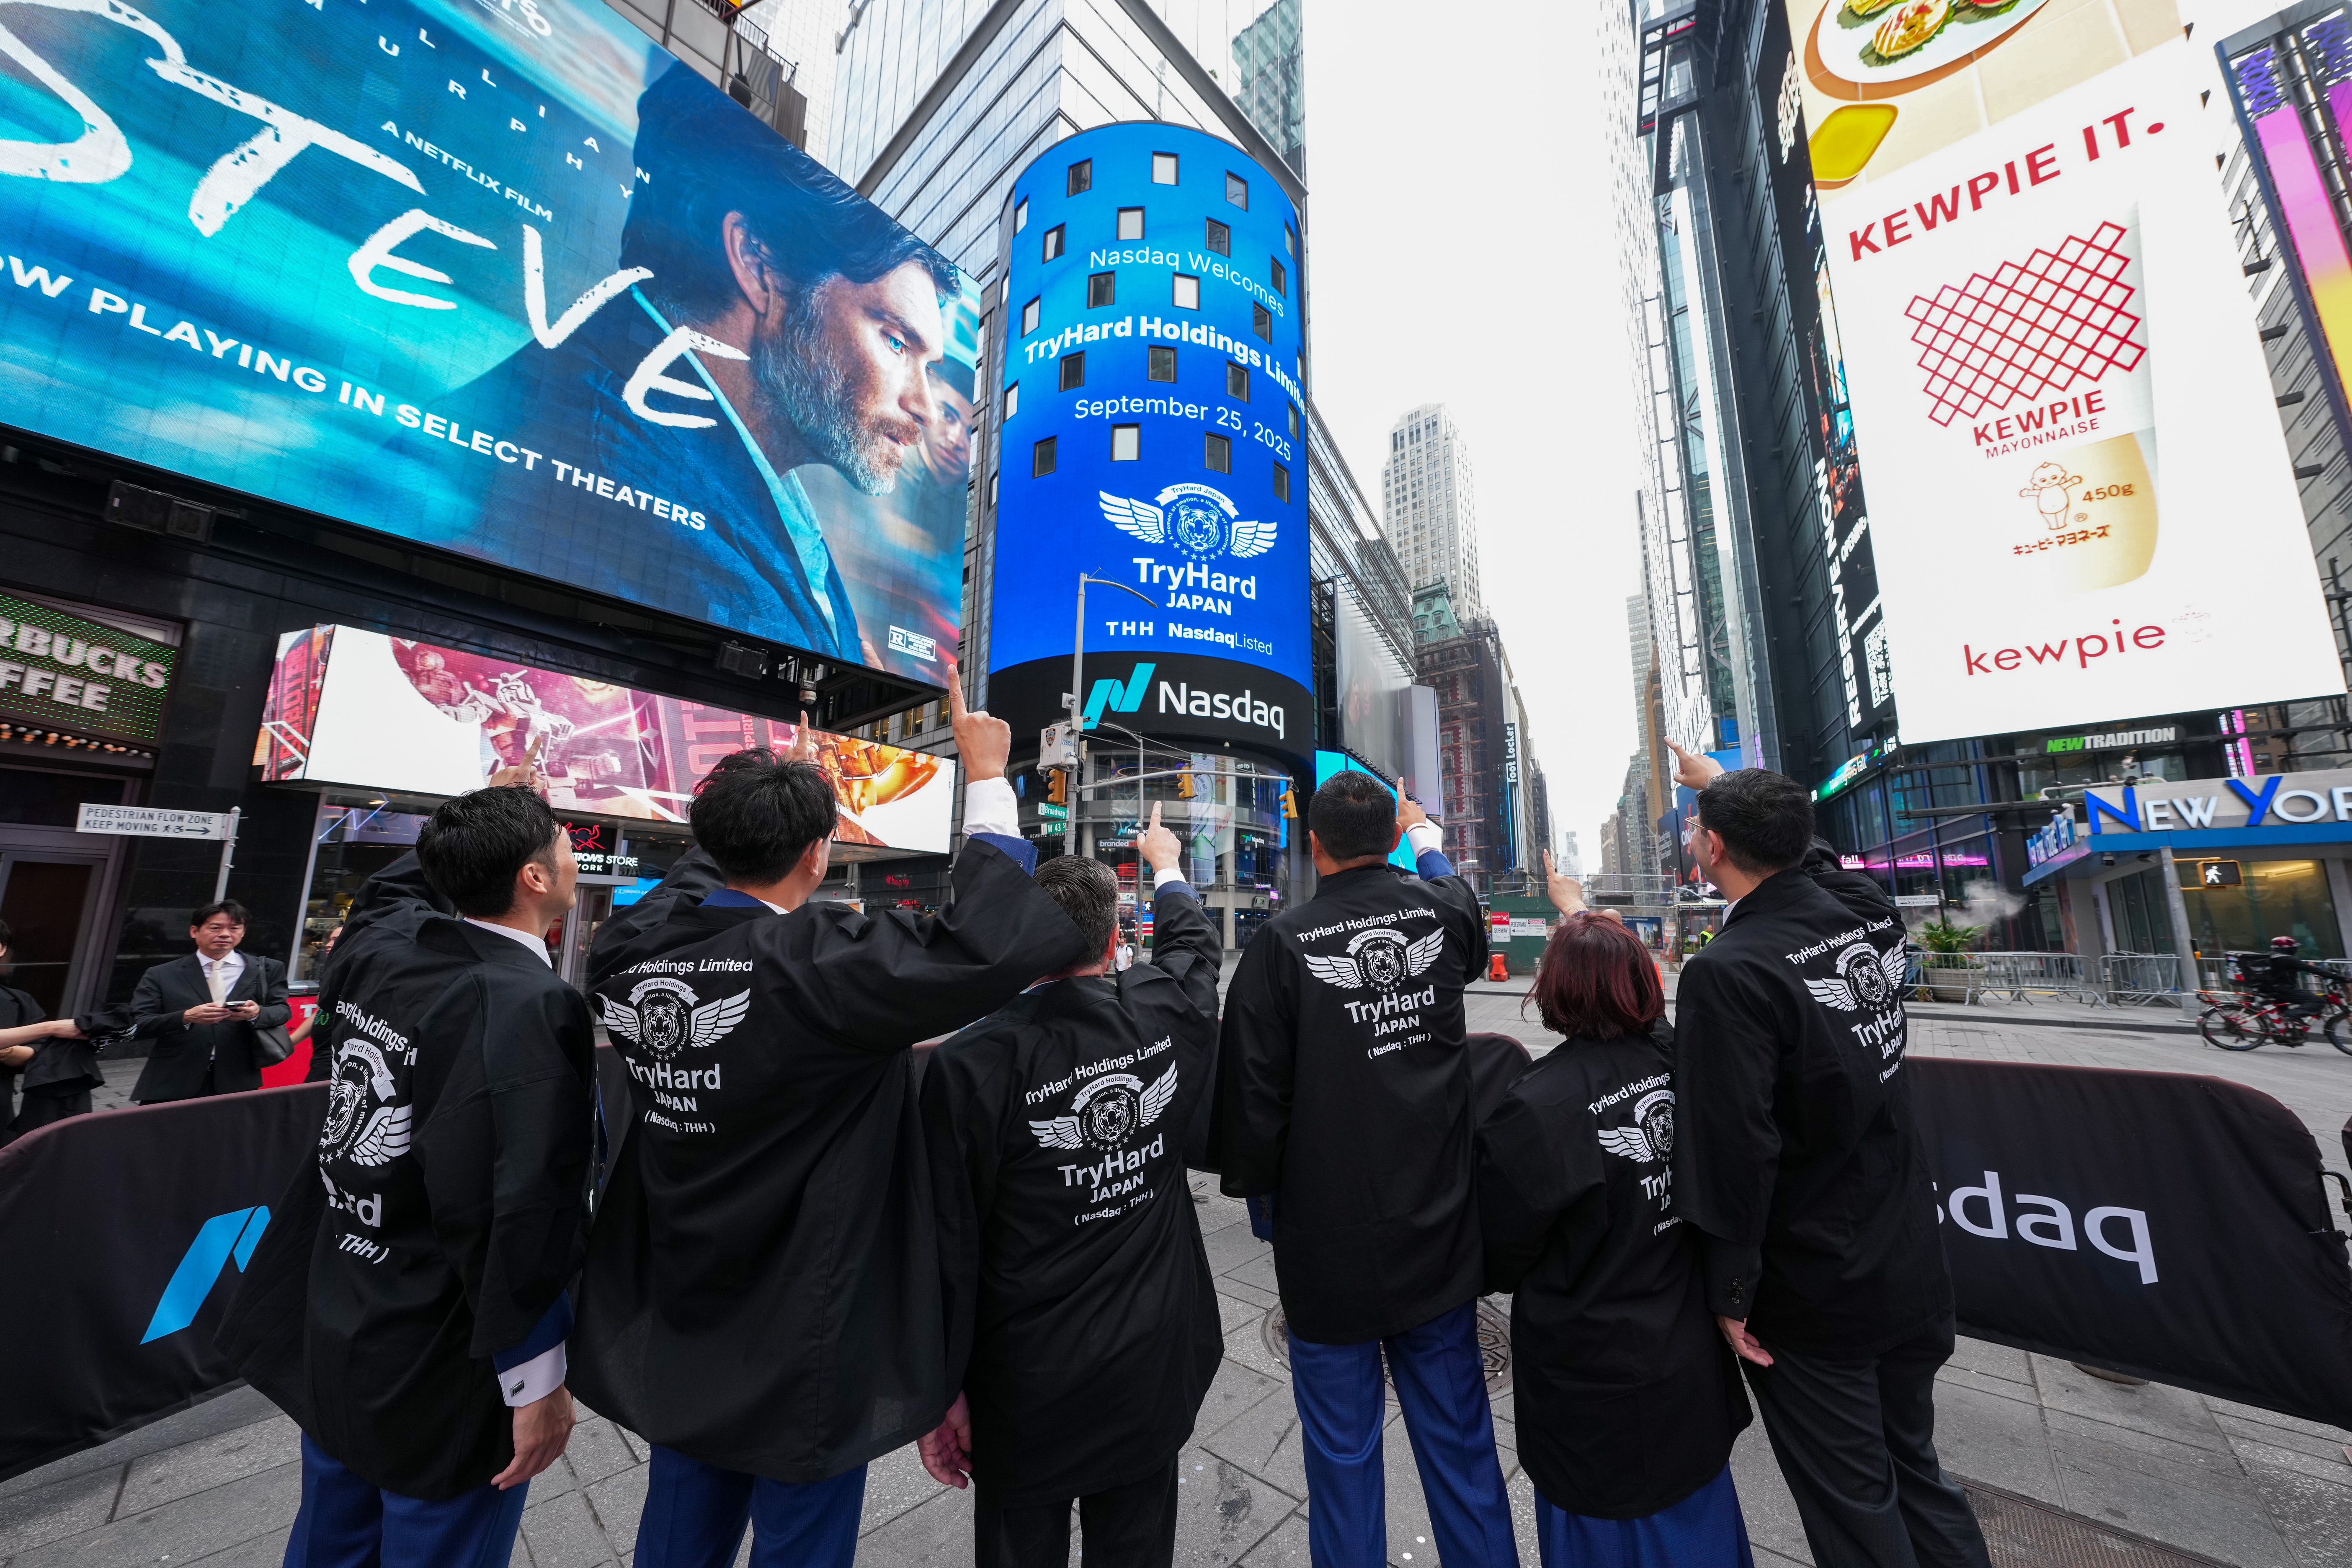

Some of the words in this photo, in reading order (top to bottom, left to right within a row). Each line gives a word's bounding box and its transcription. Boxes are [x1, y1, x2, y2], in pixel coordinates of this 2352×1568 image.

[380, 120, 400, 138] A
[405, 130, 501, 194] NETFLIX
[504, 187, 553, 222] FILM
[1849, 143, 2061, 262] KEWPIE
[2082, 106, 2165, 162] IT.
[0, 0, 751, 428] STEVE
[1091, 246, 1180, 271] Nasdaq
[1188, 251, 1284, 317] Welcomes
[1025, 316, 1132, 364] TryHard
[1140, 317, 1262, 367] Holdings
[1266, 353, 1306, 416] Limite
[88, 287, 327, 393] PLAYING
[338, 381, 385, 416] IN
[395, 404, 543, 471] SELECT
[551, 459, 707, 531] THEATERS
[1973, 389, 2106, 446] KEWPIE
[1075, 395, 1209, 420] September
[1216, 406, 1248, 438] 25,
[1254, 422, 1291, 461] 2025
[1985, 418, 2100, 459] MAYONNAISE
[1171, 485, 1202, 493] TryHard
[1203, 488, 1225, 503] Japan
[2082, 483, 2135, 502] 450g
[1176, 497, 1199, 507] emotion,
[1205, 499, 1223, 517] lifetime
[1815, 457, 1837, 558] NOW
[1133, 558, 1256, 601] TryHard
[1166, 592, 1232, 616] JAPAN
[1106, 621, 1154, 636] THH
[1829, 554, 1862, 729] RESERVE
[1963, 618, 2166, 676] kewpie
[1159, 681, 1284, 740] Nasdaq
[1505, 726, 1516, 759] Locker
[2046, 727, 2176, 753] NEWTRADITION
[1507, 761, 1517, 783] Foot
[1856, 753, 1867, 773] fall
[86, 808, 154, 820] PEDESTRIAN
[157, 813, 184, 823] FLOW
[187, 815, 214, 825] ZONE
[1044, 805, 1066, 820] Broadway
[2084, 787, 2219, 835] NEW
[84, 820, 113, 829] KEEP
[116, 822, 158, 832] MOVING
[1047, 824, 1053, 833] W
[1054, 823, 1061, 832] 43
[573, 852, 604, 863] TIONS
[606, 855, 638, 867] STORE
[1841, 855, 1859, 864] fall
[1297, 922, 1344, 943] TryHard
[1346, 913, 1398, 931] Holdings
[1353, 931, 1373, 944] TryHard
[1362, 940, 1377, 953] emotion,
[1381, 939, 1397, 949] lifetime
[1785, 941, 1828, 965] TryHard
[1825, 927, 1865, 949] Holdings
[1839, 948, 1855, 963] TryHard
[638, 959, 695, 975] Holdings
[699, 958, 753, 972] Limited
[1849, 957, 1861, 972] emotion,
[1863, 954, 1877, 963] lifetime
[636, 980, 658, 993] TryHard
[660, 980, 686, 993] Holdings
[1849, 979, 1859, 998] moment
[665, 993, 681, 1008] lifetime
[1344, 984, 1436, 1024] TryHard
[1374, 1014, 1420, 1037] JAPAN
[1373, 1041, 1402, 1057] Nasdaq
[1408, 1033, 1426, 1045] THH
[1882, 1029, 1903, 1060] JAPAN
[365, 1046, 384, 1078] Holdings
[1074, 1054, 1134, 1080] Holdings
[1136, 1035, 1172, 1061] Limited
[625, 1055, 721, 1090] TryHard
[1628, 1072, 1671, 1096] Holdings
[1080, 1079, 1105, 1098] TryHard
[1089, 1091, 1109, 1108] emotion,
[1114, 1088, 1131, 1098] lifetime
[362, 1099, 367, 1109] of
[654, 1090, 697, 1112] JAPAN
[1636, 1095, 1654, 1112] TryHard
[650, 1112, 678, 1133] Nasdaq
[683, 1122, 708, 1133] THH
[1648, 1105, 1659, 1121] emotion,
[343, 1111, 366, 1151] memories
[1646, 1128, 1655, 1149] moment
[1057, 1132, 1164, 1189] TryHard
[1089, 1171, 1144, 1204] JAPAN
[1081, 1205, 1121, 1223] Nasdaq
[1129, 1191, 1148, 1208] THH
[339, 1233, 381, 1256] THH
